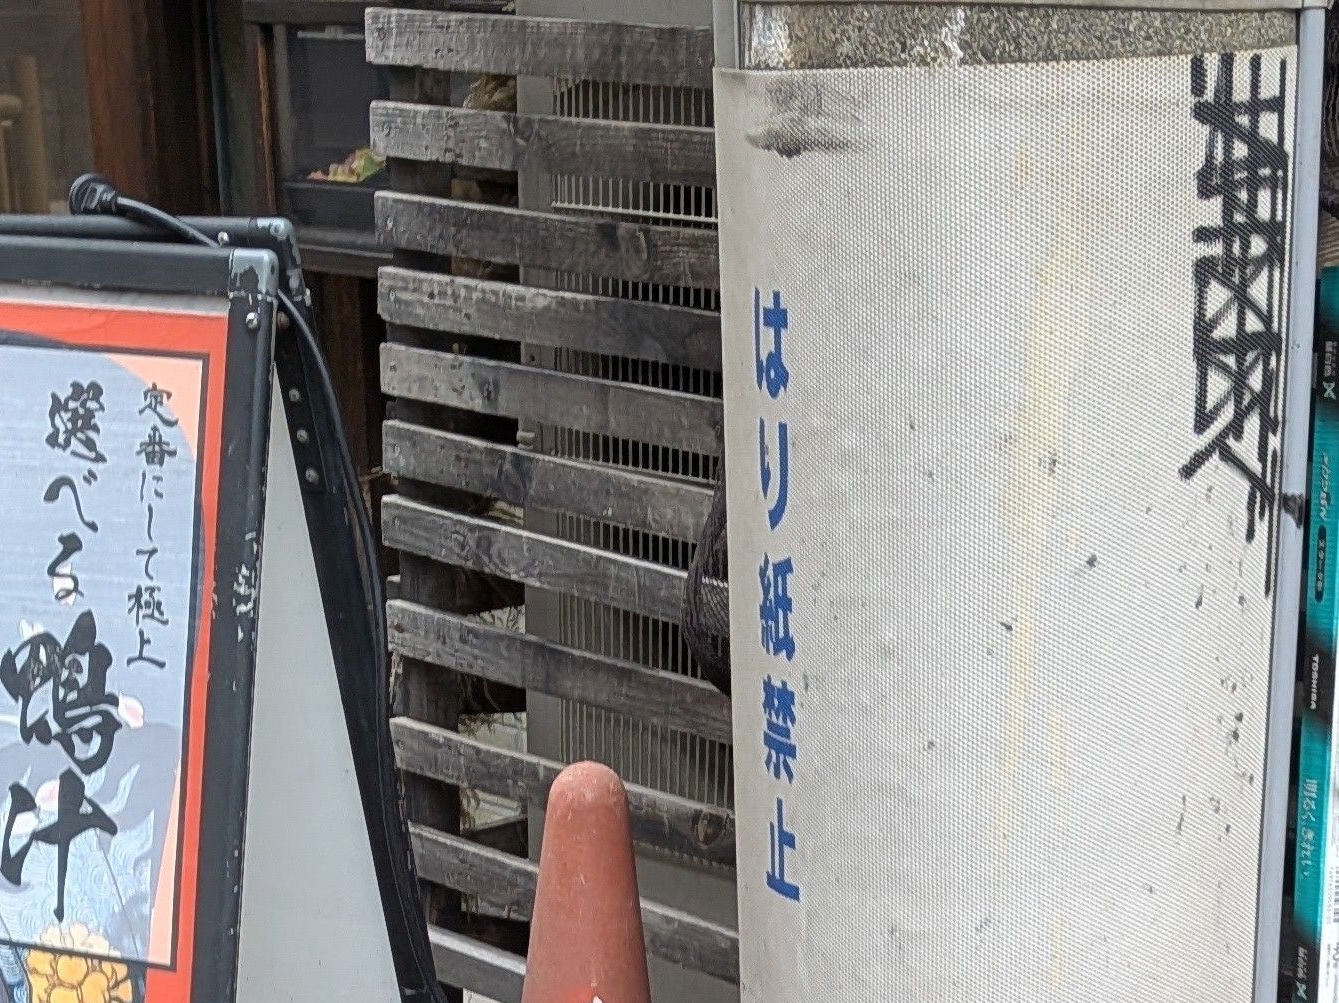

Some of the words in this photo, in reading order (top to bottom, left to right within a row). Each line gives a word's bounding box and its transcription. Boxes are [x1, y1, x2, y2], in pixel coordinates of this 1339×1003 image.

[0, 380, 123, 923] 選べる鴨汁
[125, 381, 178, 669] 定番にして極上
[753, 286, 801, 902] はり紙禁止
[1310, 653, 1320, 710] TOSHIBA
